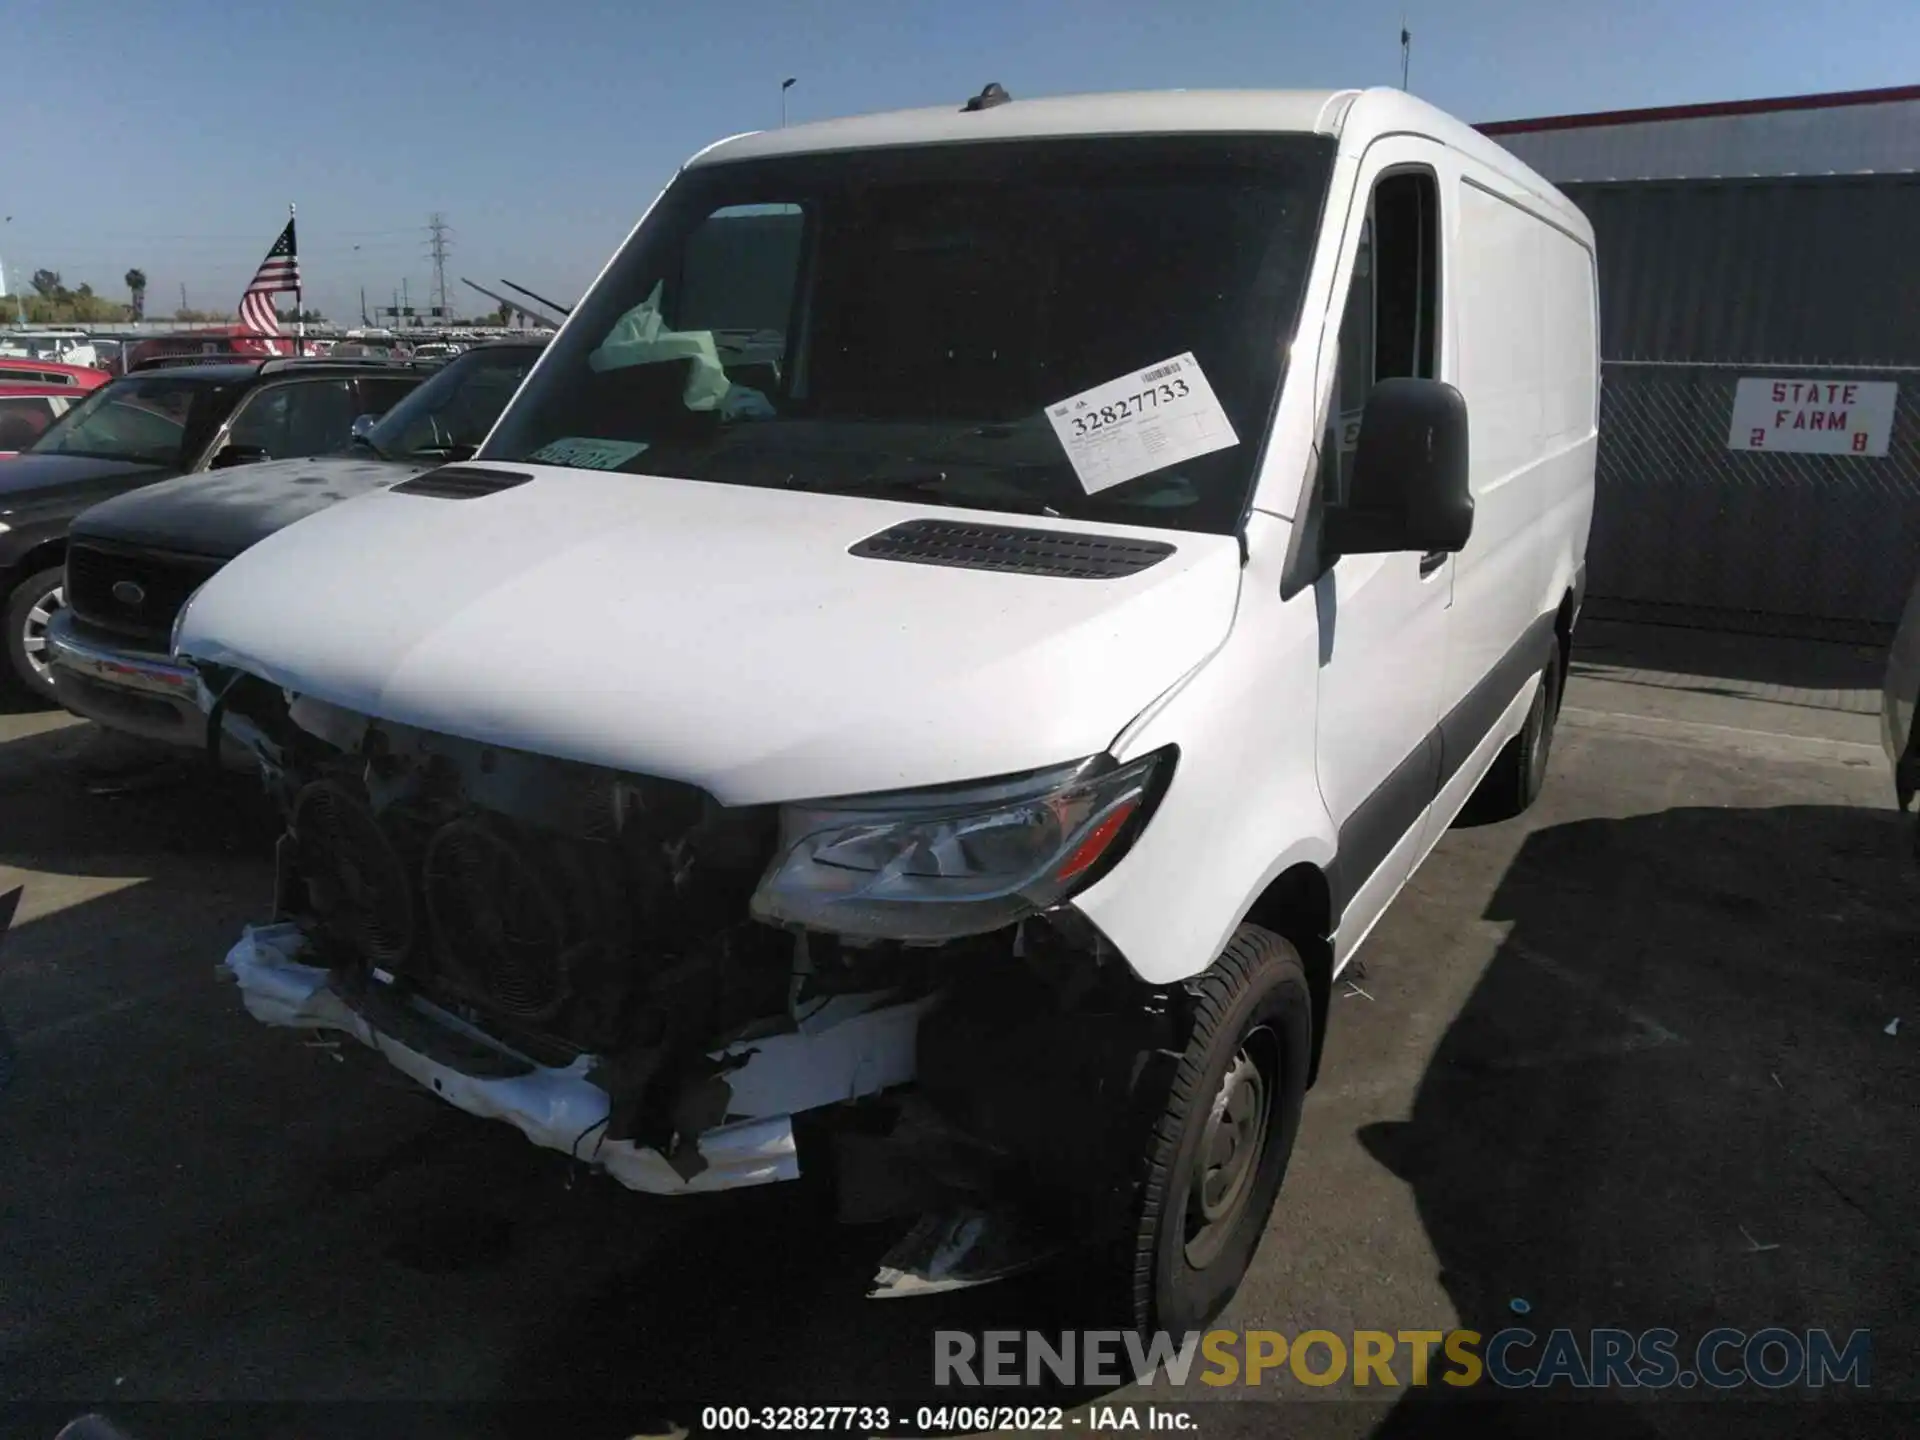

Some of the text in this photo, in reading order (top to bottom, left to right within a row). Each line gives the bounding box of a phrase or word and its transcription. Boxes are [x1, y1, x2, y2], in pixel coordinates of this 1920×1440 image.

[1772, 381, 1860, 405] STATE
[1072, 379, 1190, 437] 32827733
[1775, 409, 1848, 431] FARM
[1749, 427, 1766, 447] 2
[1851, 431, 1868, 452] 8
